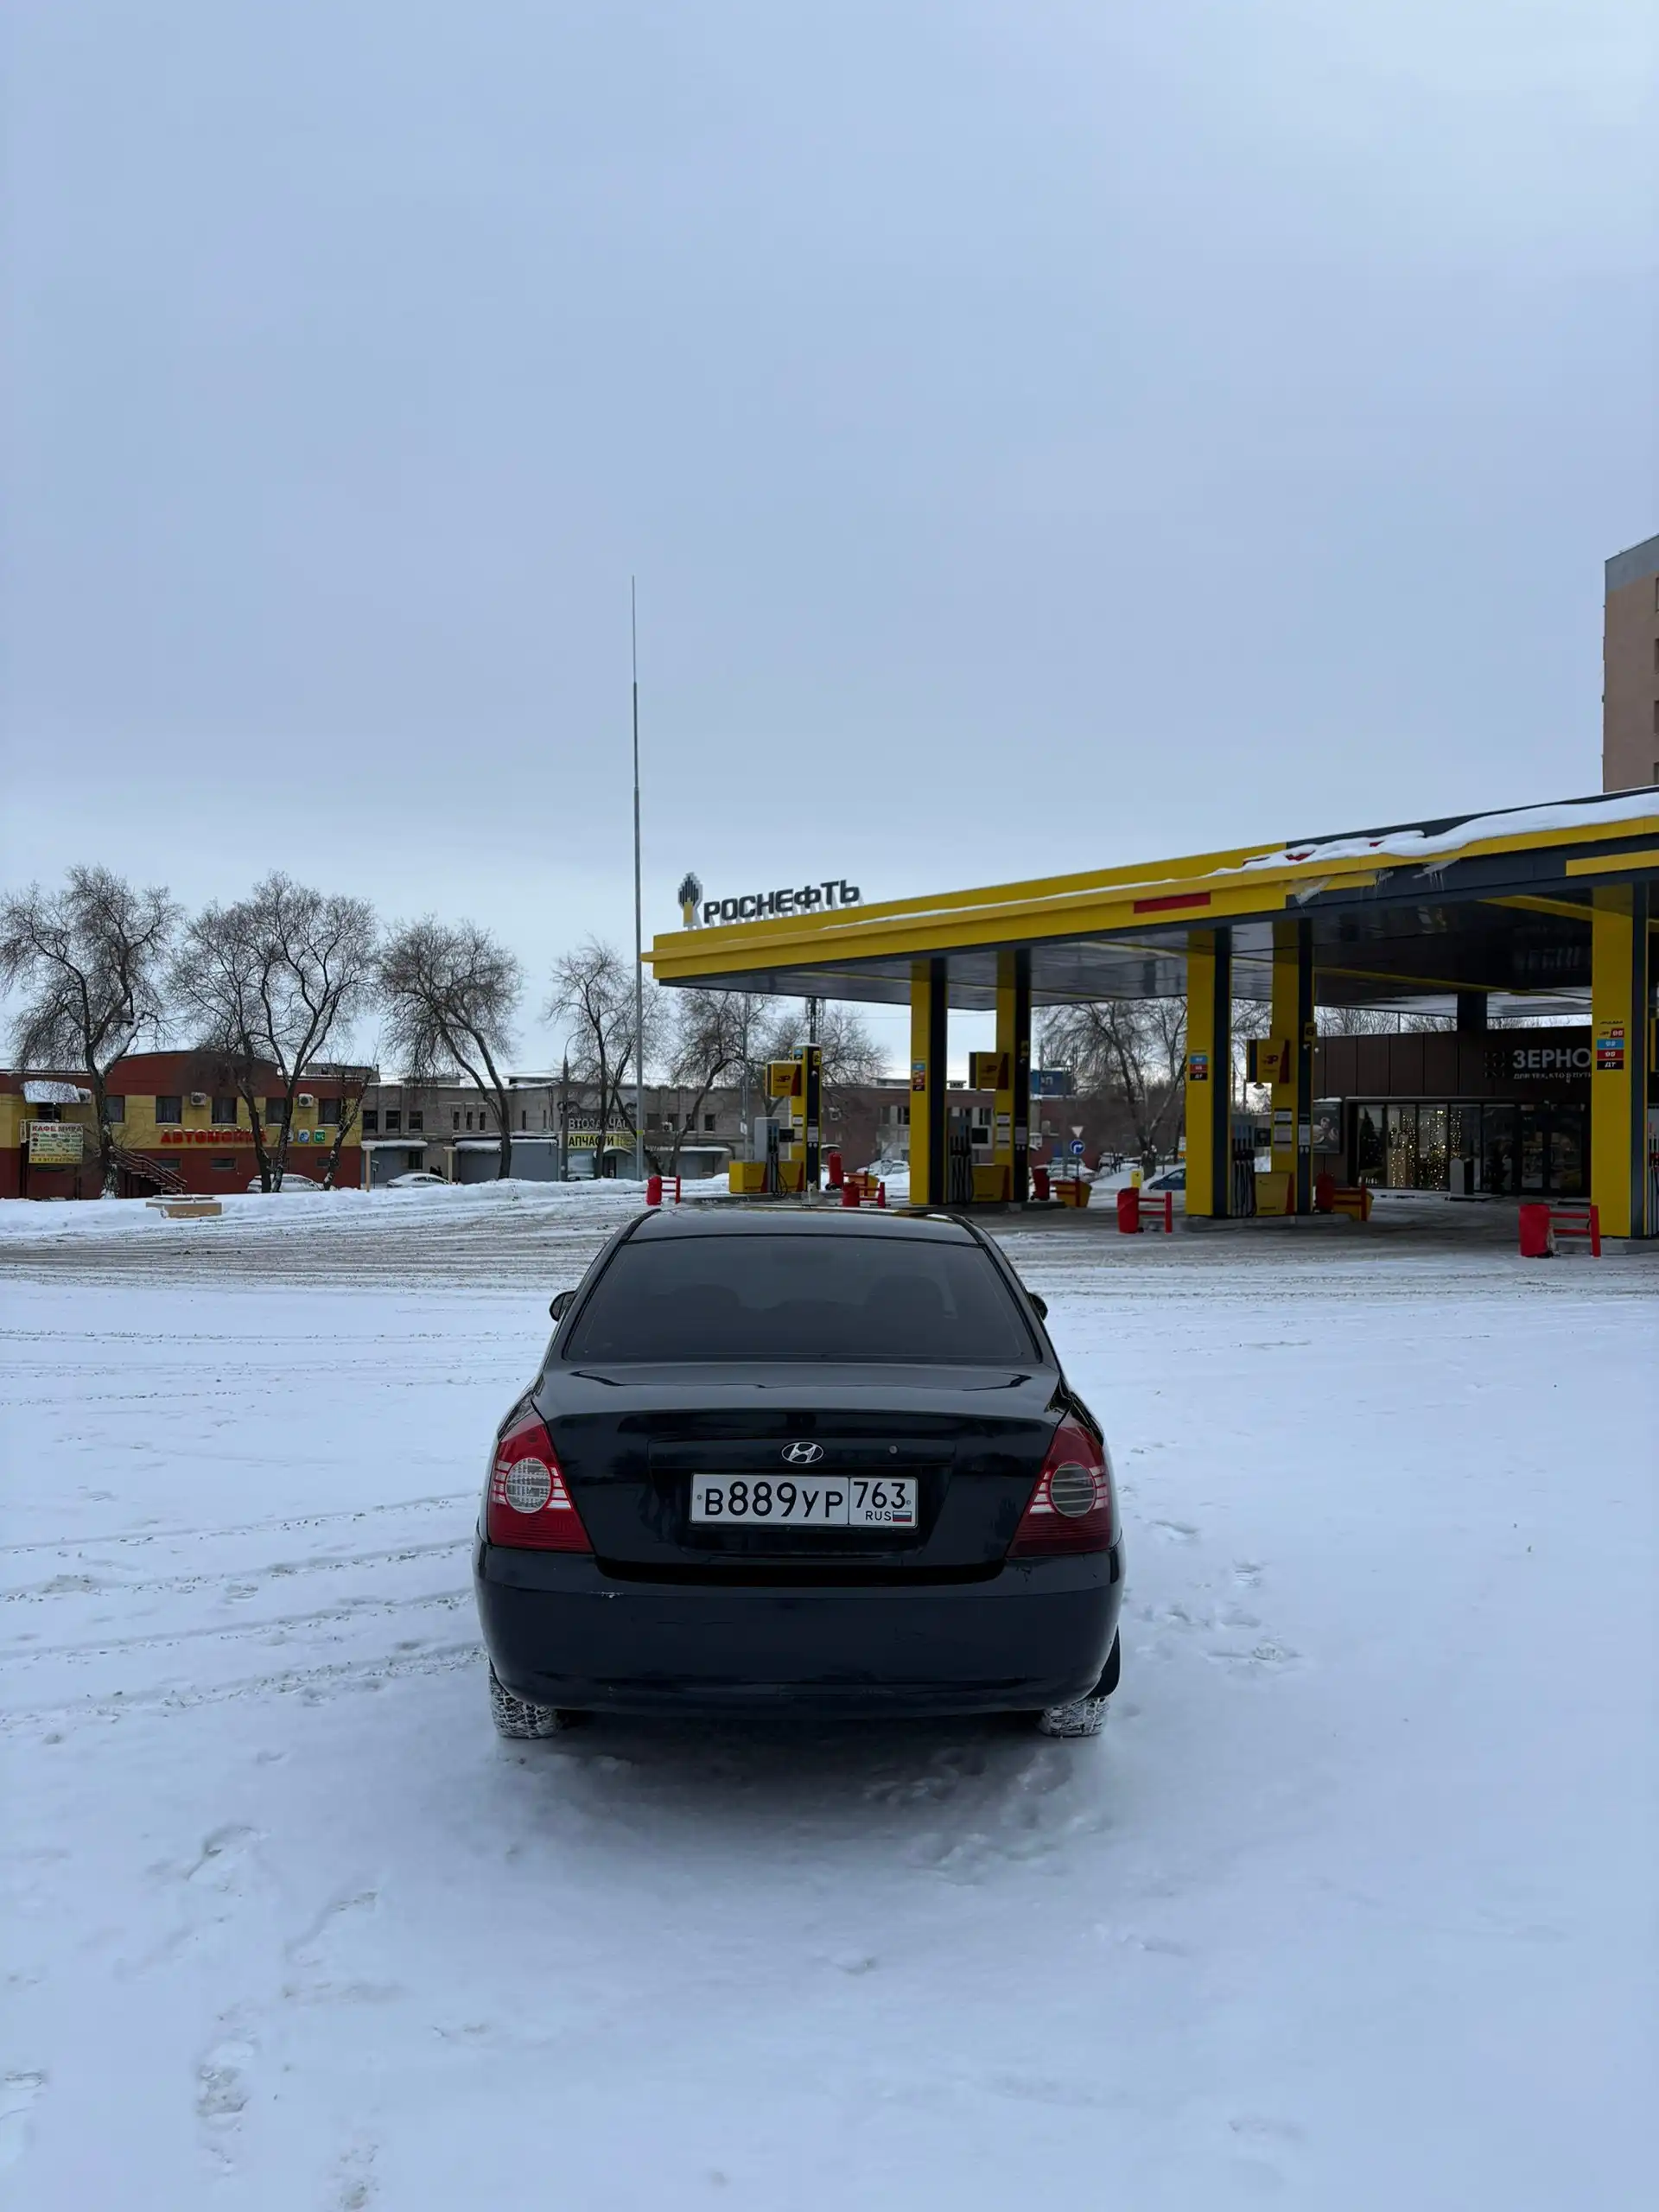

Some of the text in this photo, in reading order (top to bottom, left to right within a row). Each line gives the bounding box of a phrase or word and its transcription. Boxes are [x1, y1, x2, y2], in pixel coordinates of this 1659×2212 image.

[703, 879, 860, 924] РОСНЕФТЬ
[1512, 1047, 1592, 1069] ЗЕРНО
[569, 1135, 614, 1147] АПЧАСИ
[704, 1480, 906, 1518] В889УР 763
[865, 1510, 892, 1521] RUS
